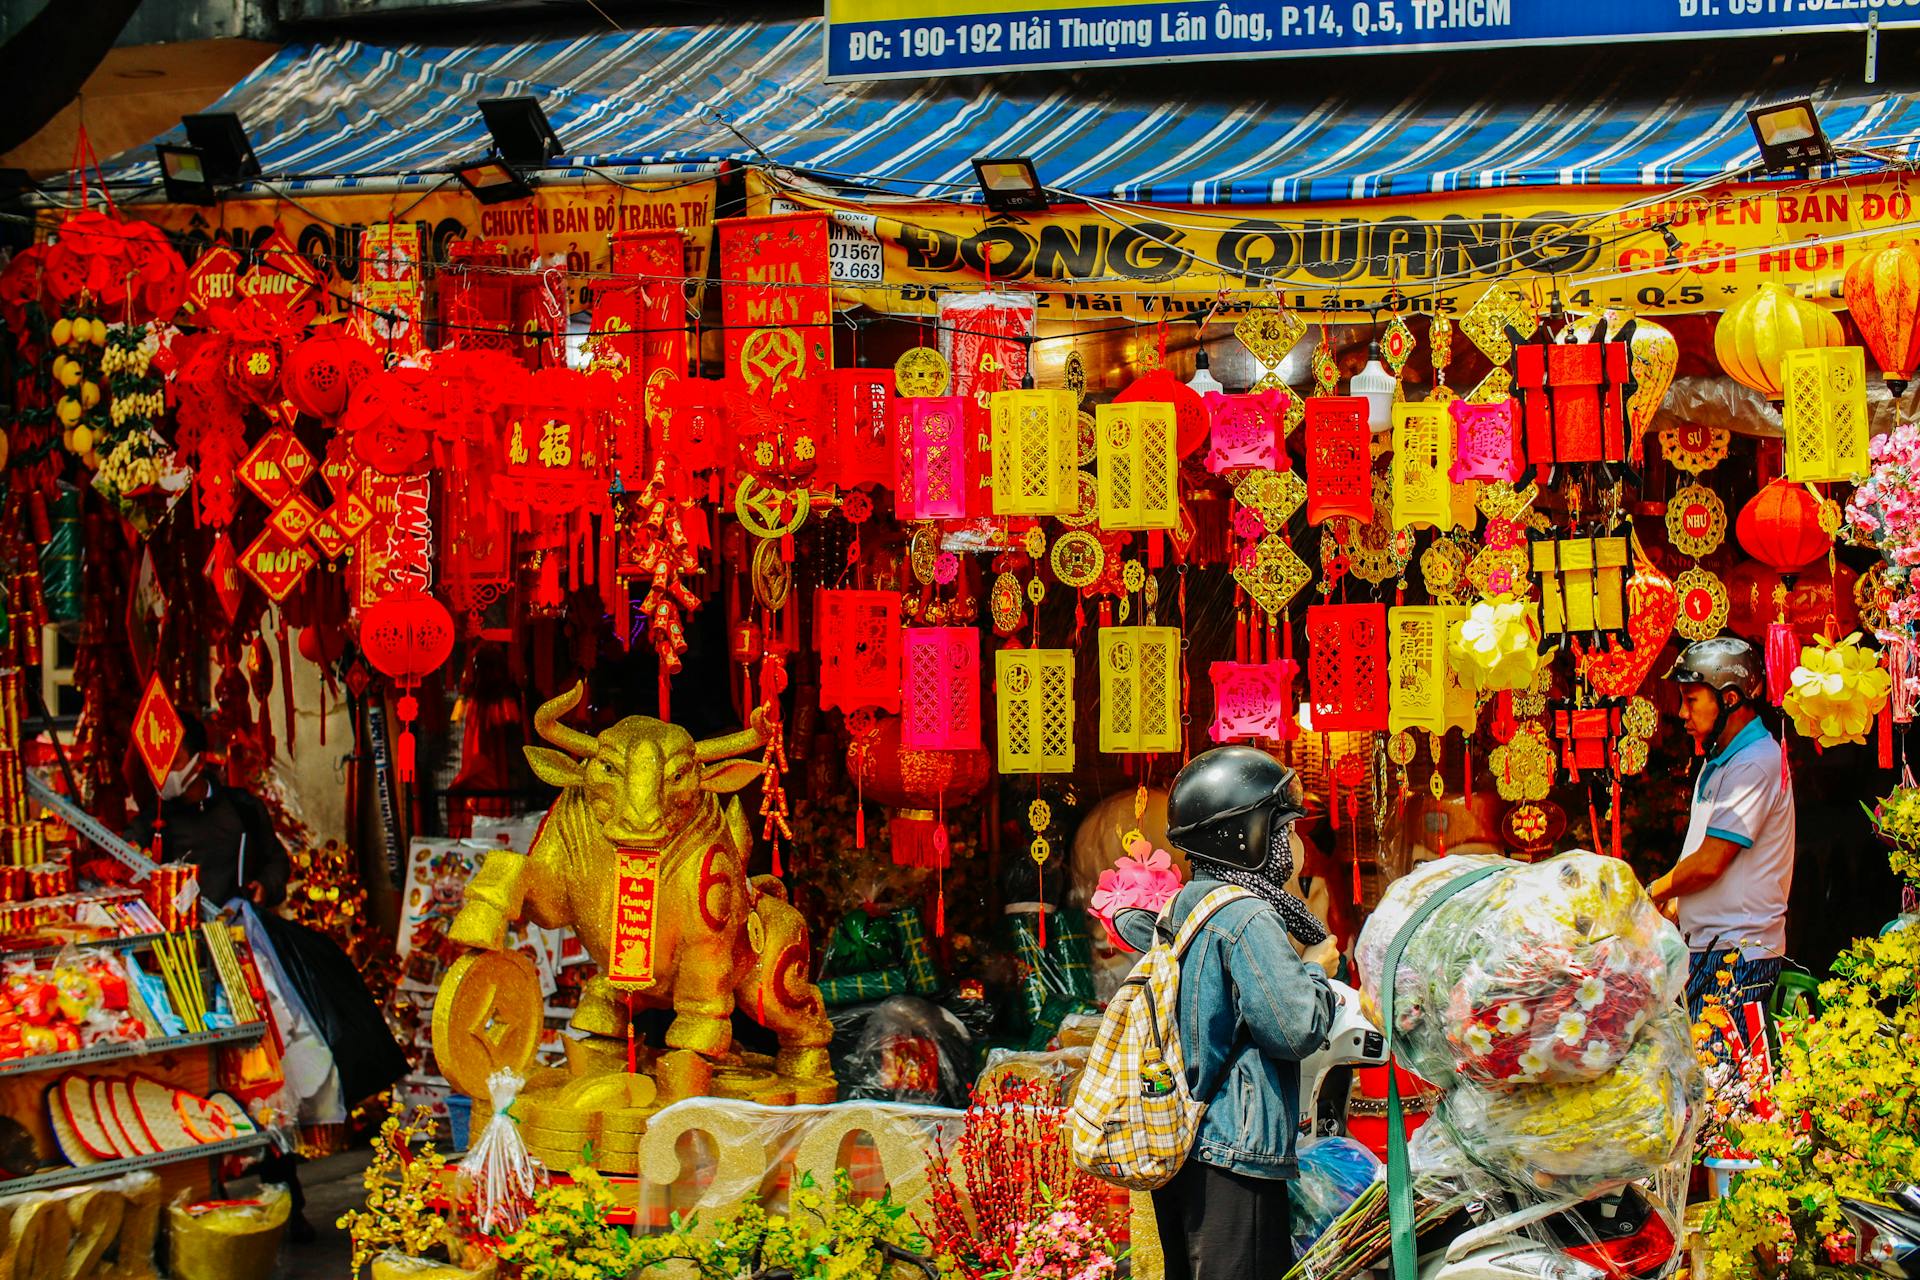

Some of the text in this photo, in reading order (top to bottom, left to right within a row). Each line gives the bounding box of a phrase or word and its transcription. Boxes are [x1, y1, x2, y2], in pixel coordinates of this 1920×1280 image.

[849, 0, 1511, 61] ĐC: 190-192 Hải Thượng Lãn Ông, P.14, Q.5, TP.HCM
[482, 194, 709, 237] CHUYÊN BÁN ĐỒ TRANG TRÍ
[1007, 197, 1023, 205] LED
[1619, 191, 1761, 230] CHUYÊN
[1777, 187, 1849, 224] BÁN
[895, 210, 1602, 288] ĐÔNG QUANG
[1064, 290, 1123, 312] Hải
[1137, 295, 1252, 316] Thượn
[1381, 288, 1458, 314] Ông
[1637, 286, 1704, 307] Q.5
[538, 418, 571, 468] 福
[1686, 512, 1708, 528] NHƯ
[620, 894, 651, 910] Khang
[629, 881, 644, 893] An
[623, 909, 647, 923] Thịnh
